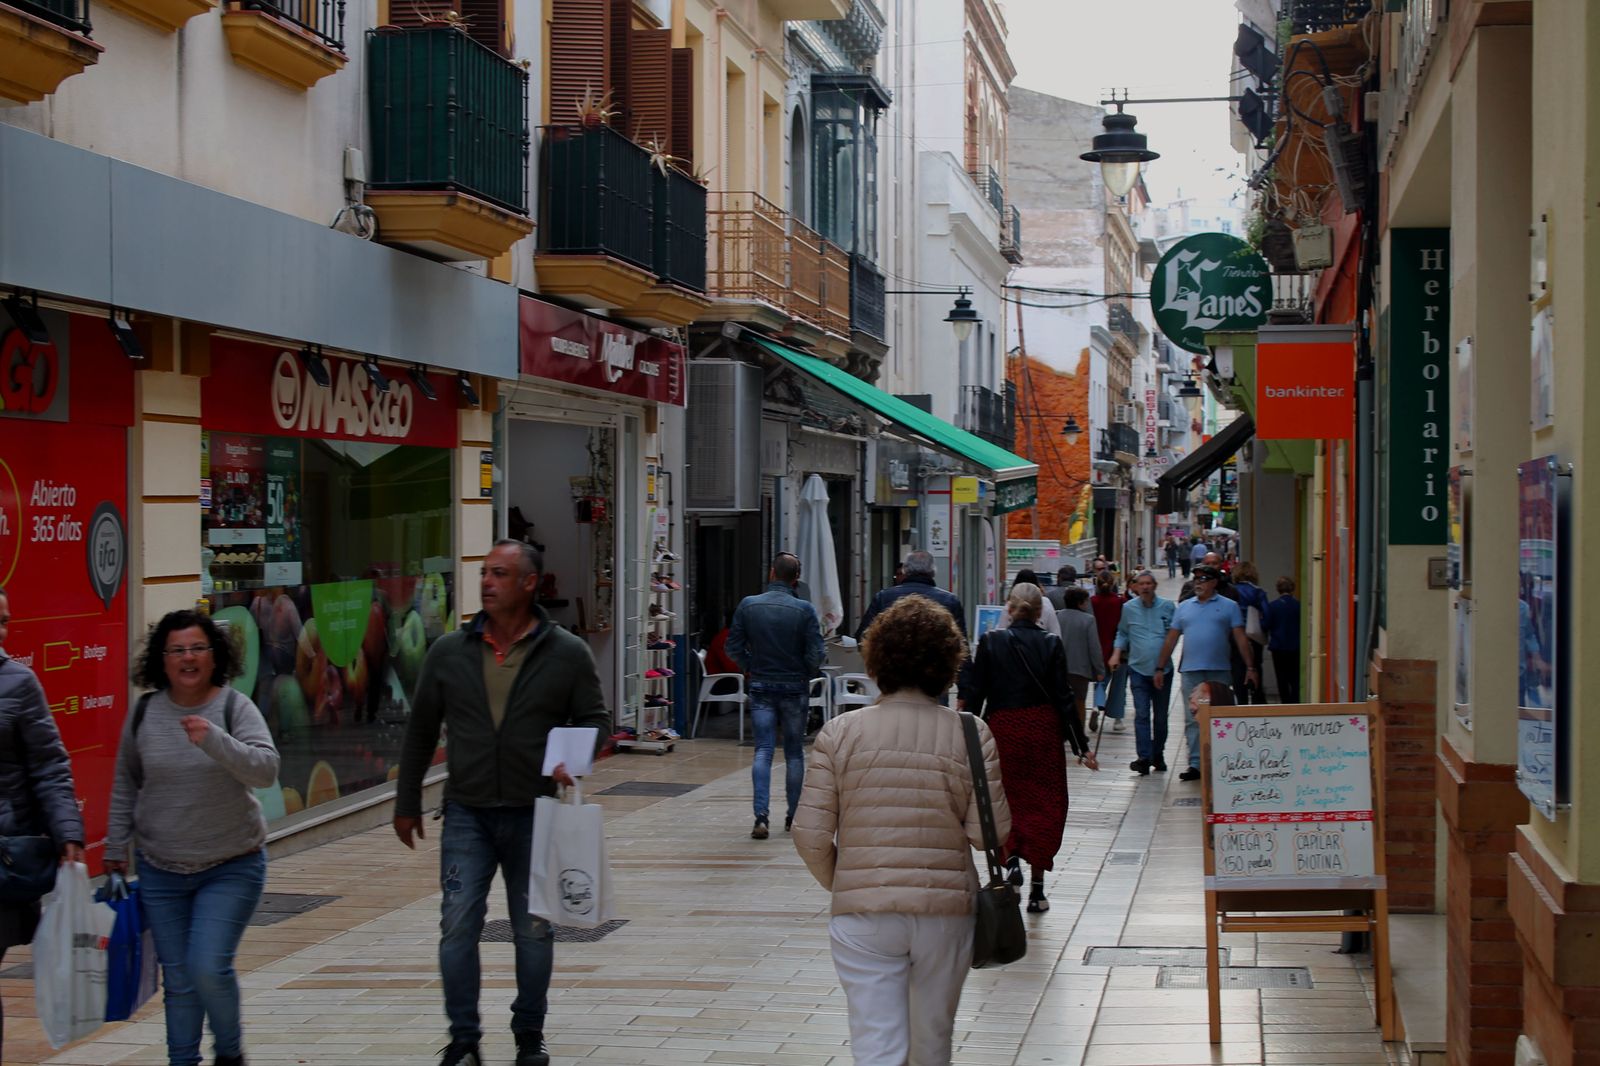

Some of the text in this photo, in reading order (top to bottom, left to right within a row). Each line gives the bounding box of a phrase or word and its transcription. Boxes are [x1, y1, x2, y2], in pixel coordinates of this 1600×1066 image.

[297, 358, 413, 438] MAS&GO
[1265, 385, 1345, 398] bankinter
[1419, 249, 1445, 522] Herbolario
[30, 479, 77, 507] Abierto
[267, 482, 285, 525] 50
[30, 514, 83, 542] 365 días
[99, 541, 116, 571] ifa
[1236, 719, 1344, 747] Ofertas marzo
[1258, 749, 1290, 769] Real
[1220, 833, 1274, 851] OMEGA 3
[1296, 835, 1341, 850] CAPILAR
[1224, 855, 1243, 871] 150
[1297, 853, 1342, 871] BIOTINA
